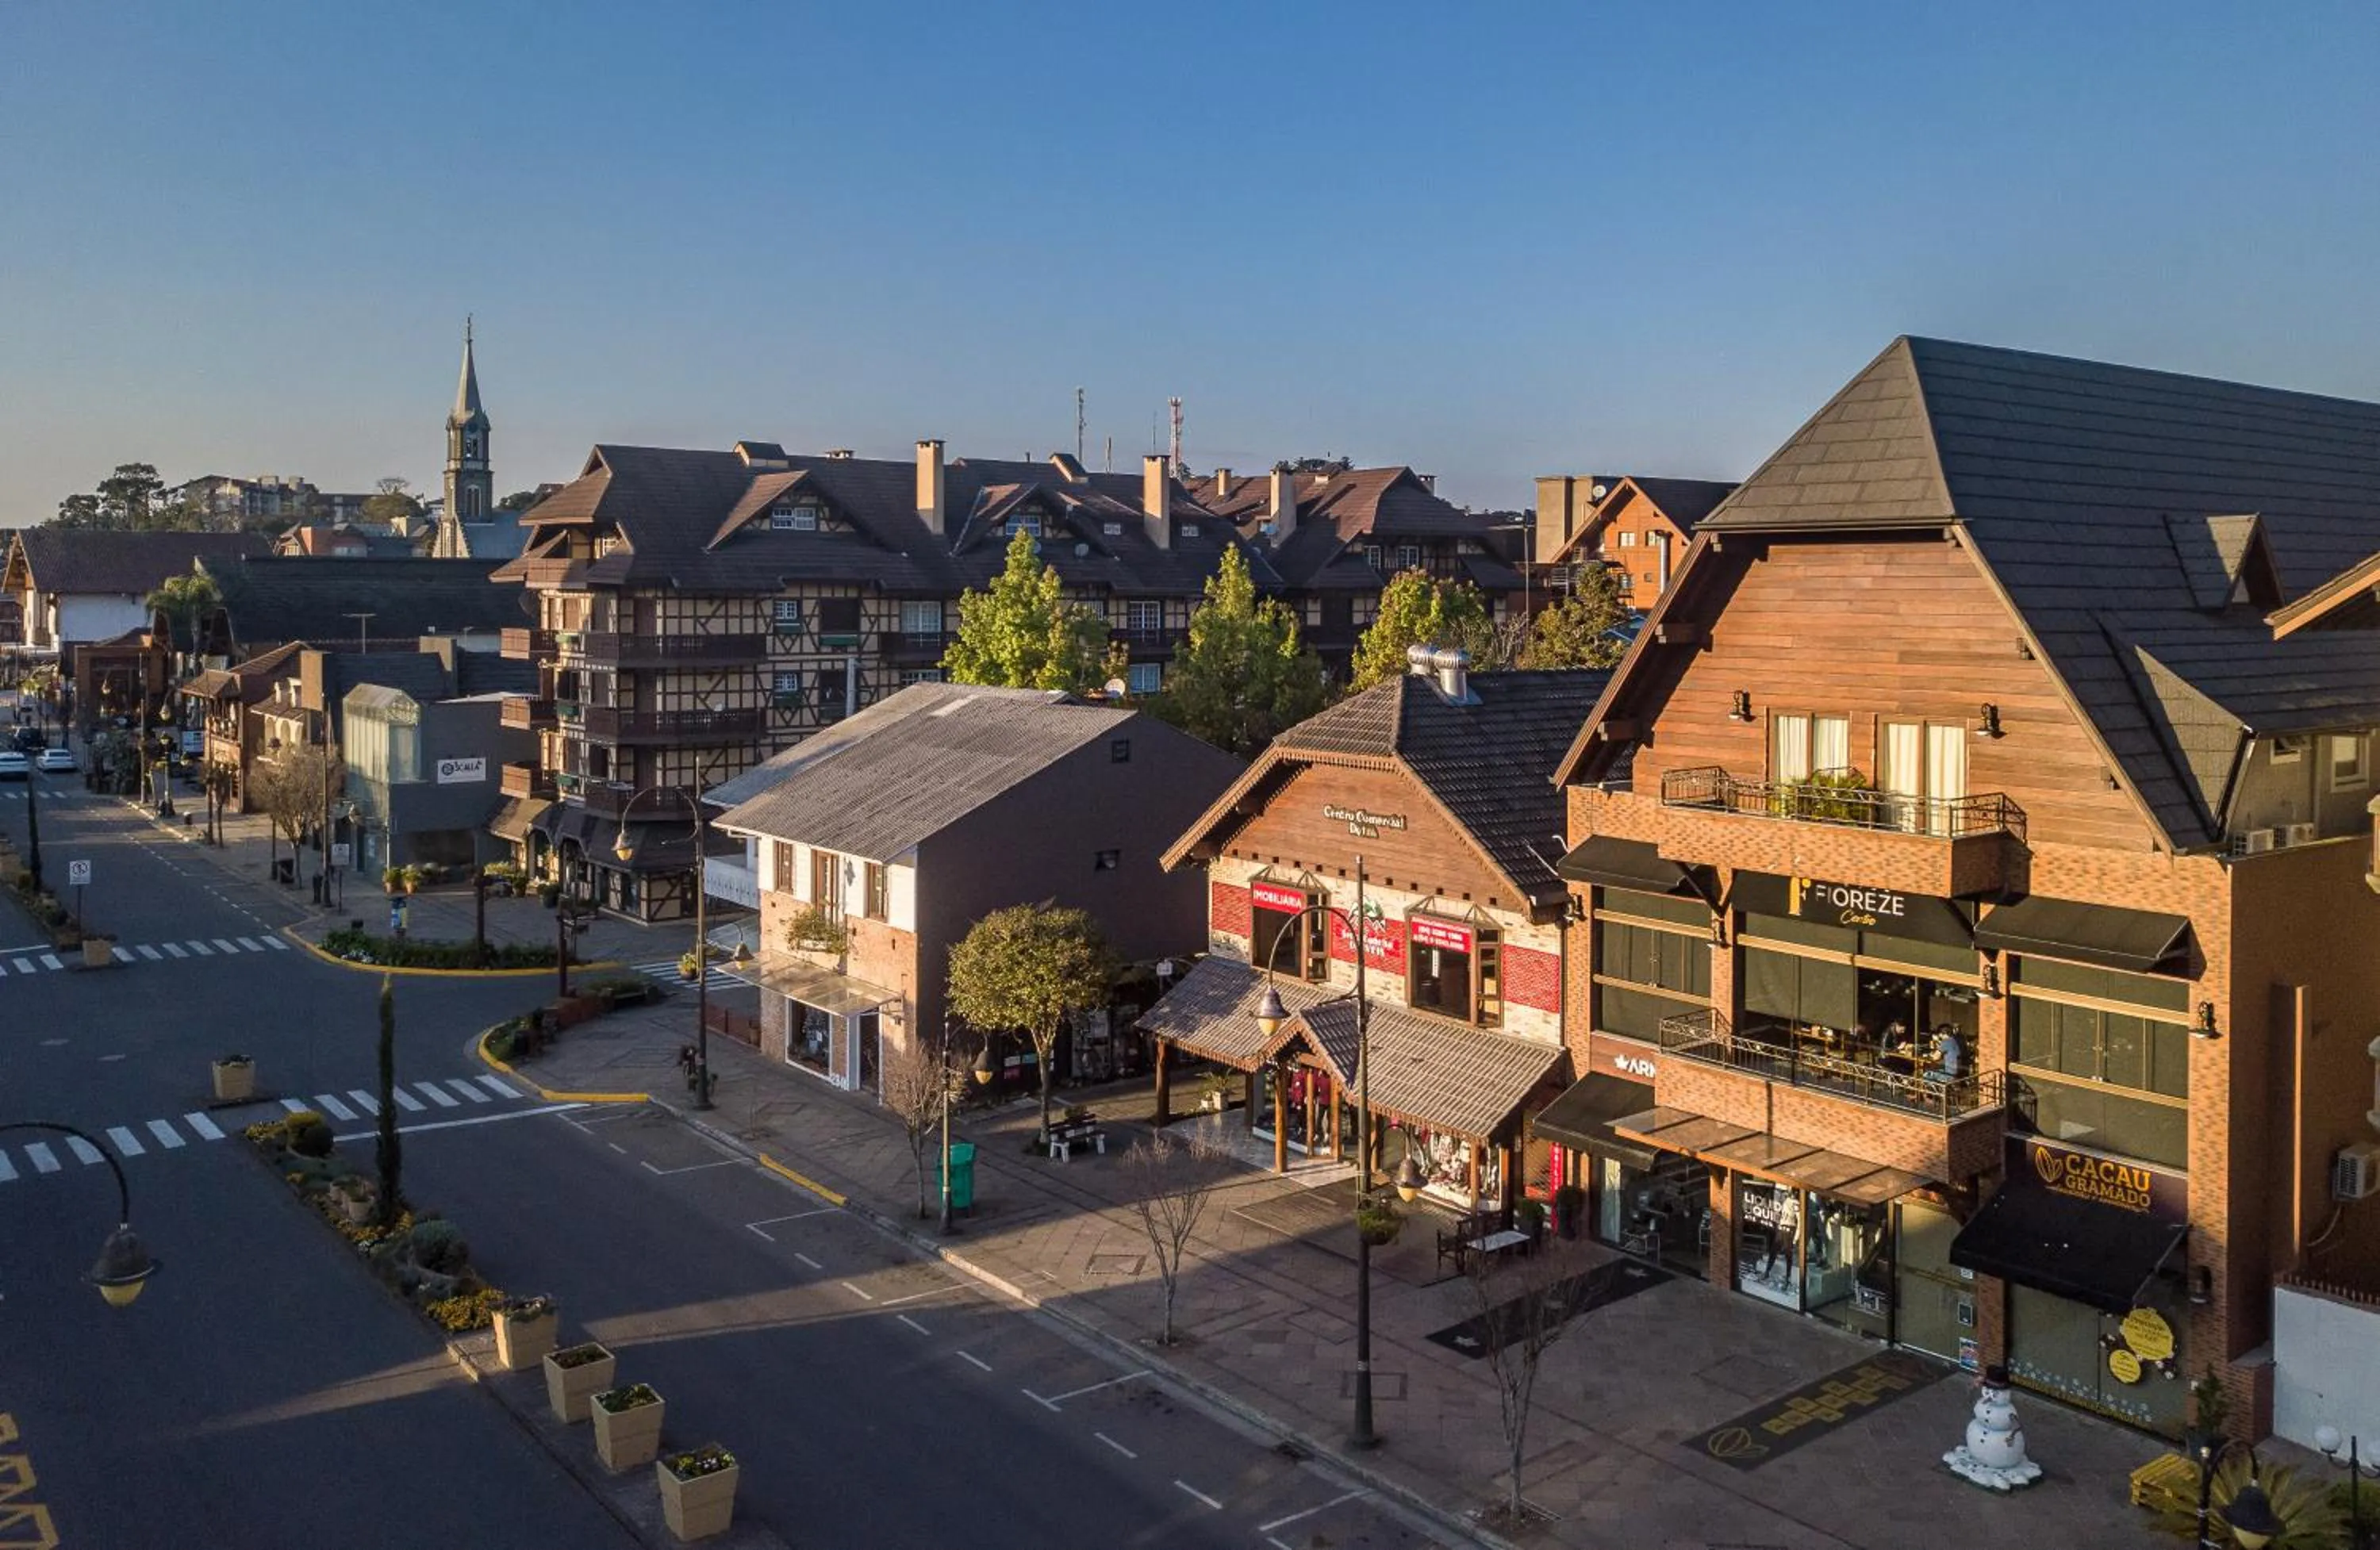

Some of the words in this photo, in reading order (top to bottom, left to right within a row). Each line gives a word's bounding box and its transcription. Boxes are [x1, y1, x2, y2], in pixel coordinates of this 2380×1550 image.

[1323, 804, 1355, 821] Centro
[1356, 810, 1406, 830] Comercial
[1815, 884, 1905, 916] FIOREZE
[2065, 1153, 2152, 1193] CACAU
[2065, 1174, 2152, 1209] GRAMADO
